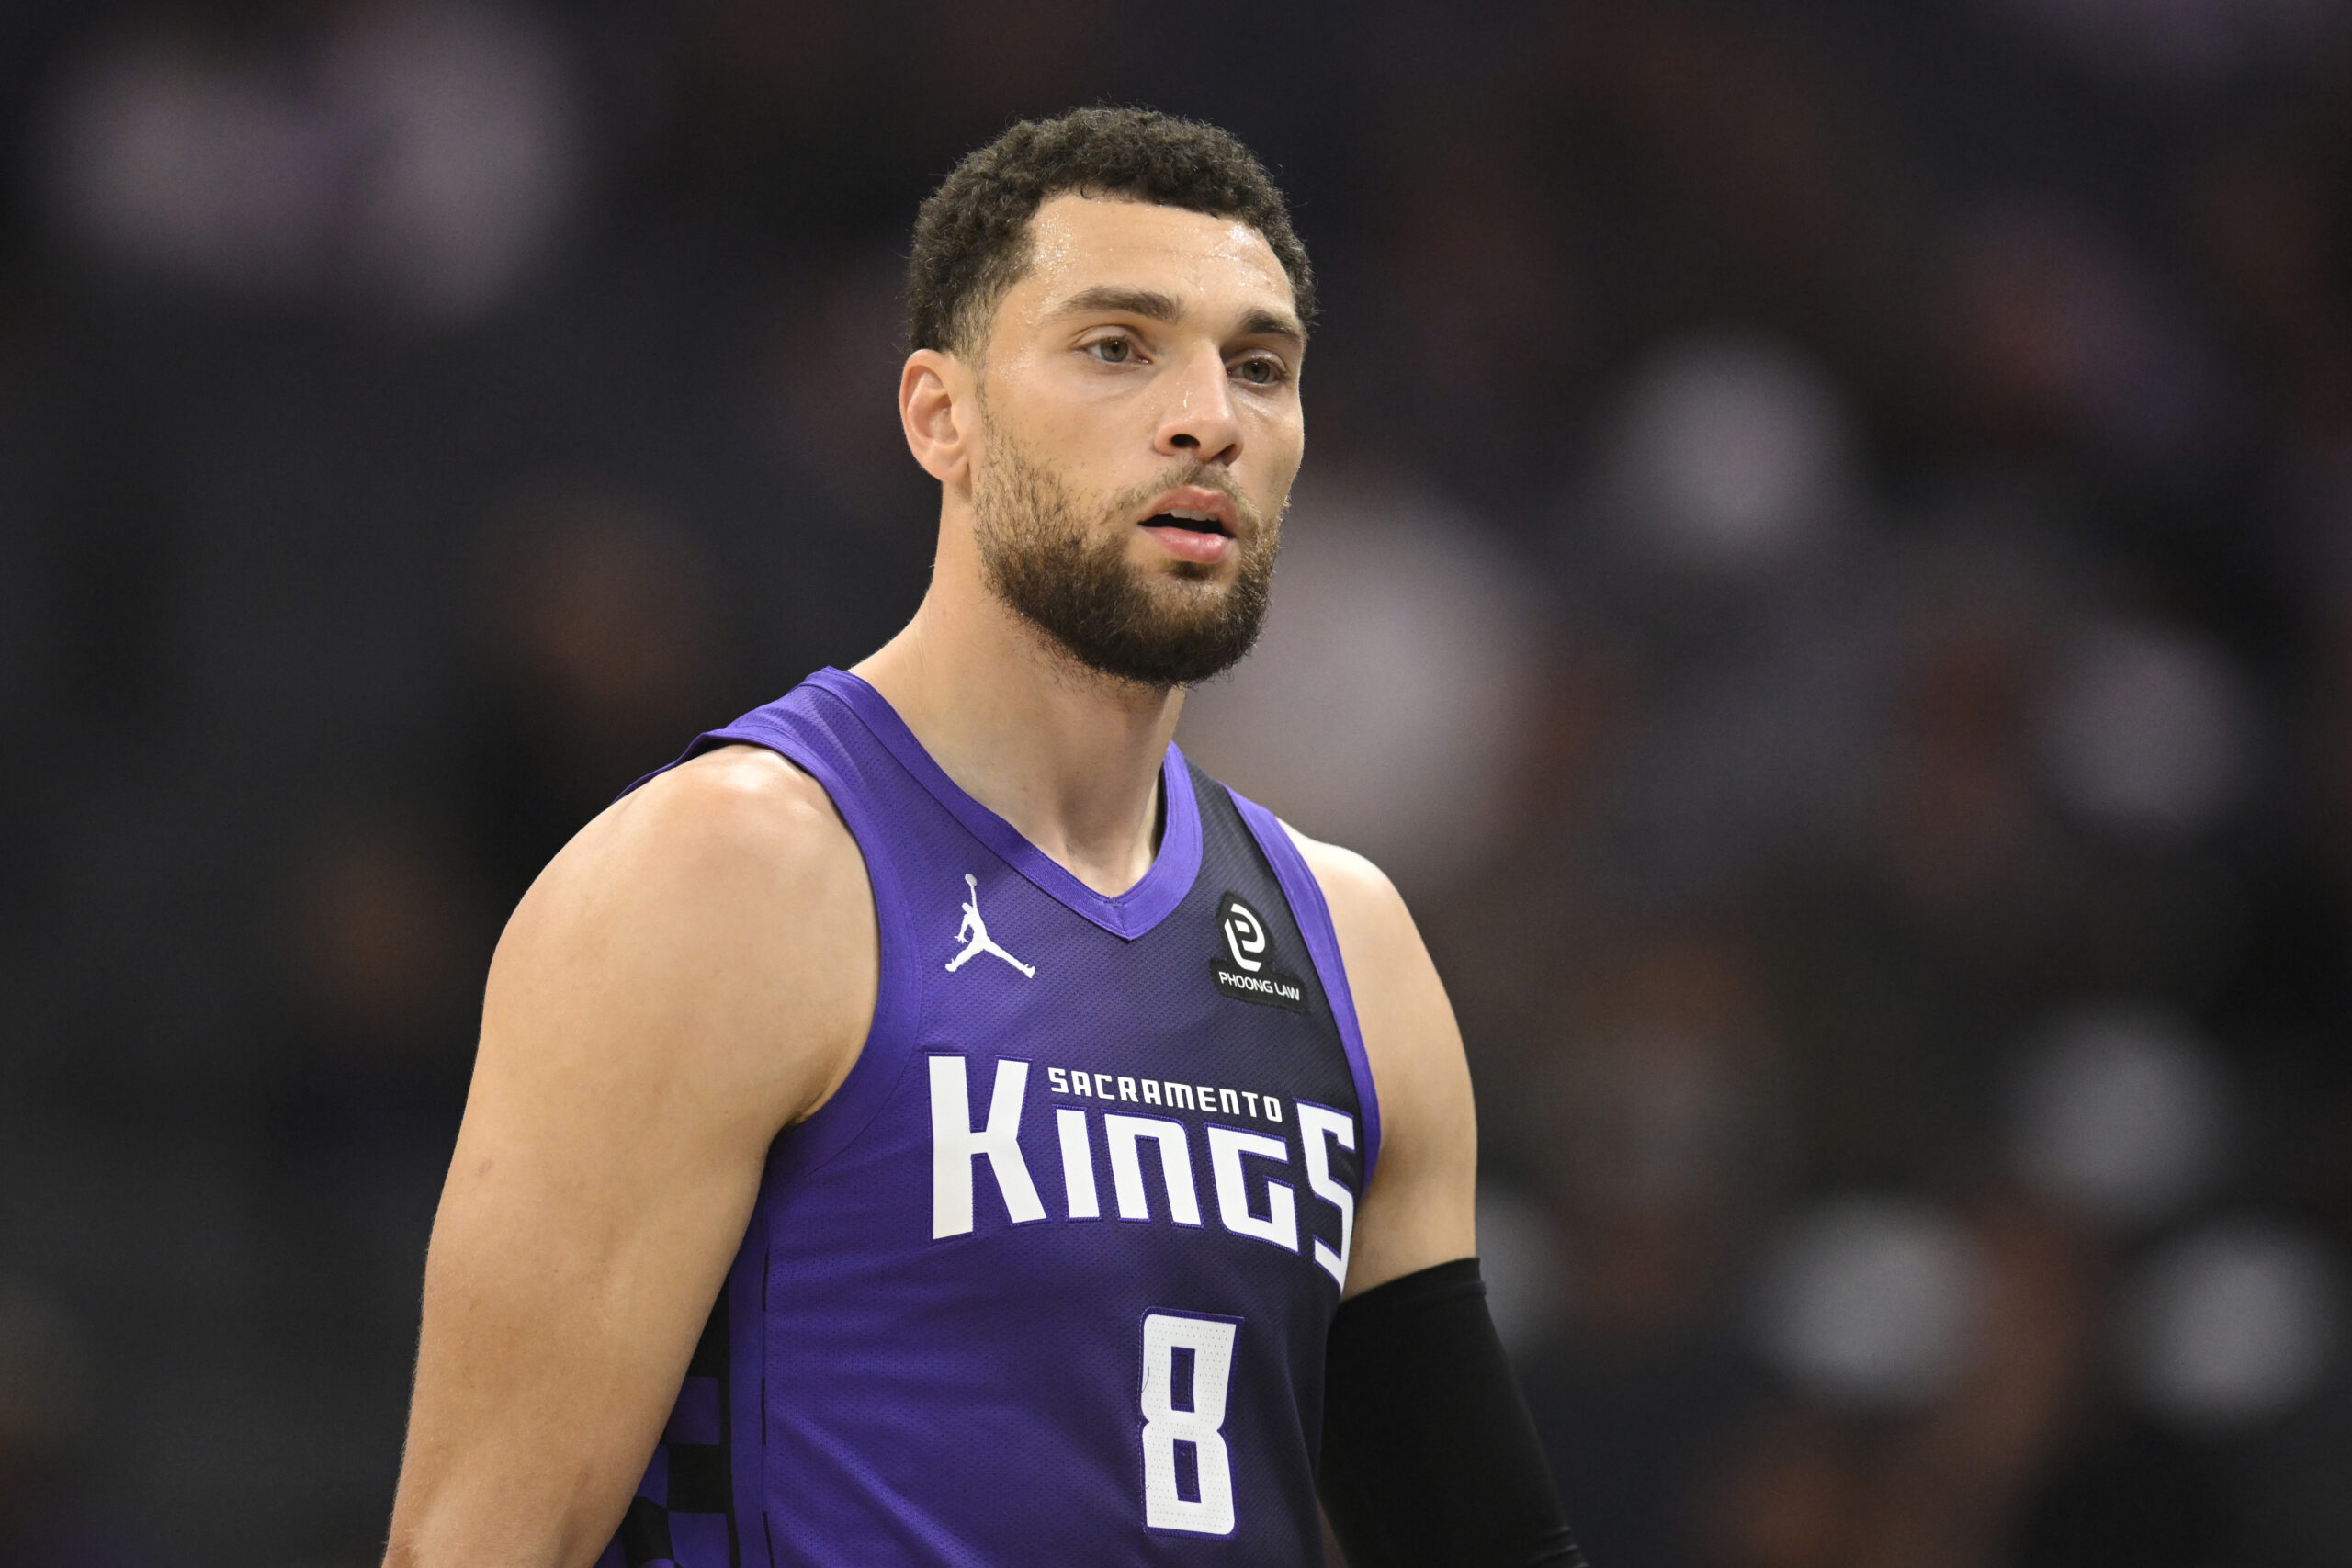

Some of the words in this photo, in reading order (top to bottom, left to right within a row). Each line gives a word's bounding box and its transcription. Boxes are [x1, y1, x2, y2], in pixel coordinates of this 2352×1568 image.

[1218, 971, 1273, 994] PHOONG
[1274, 982, 1300, 1001] LAW
[1047, 1067, 1283, 1123] SACRAMENTO
[928, 1055, 1355, 1295] KINGS
[1140, 1314, 1237, 1535] 8
